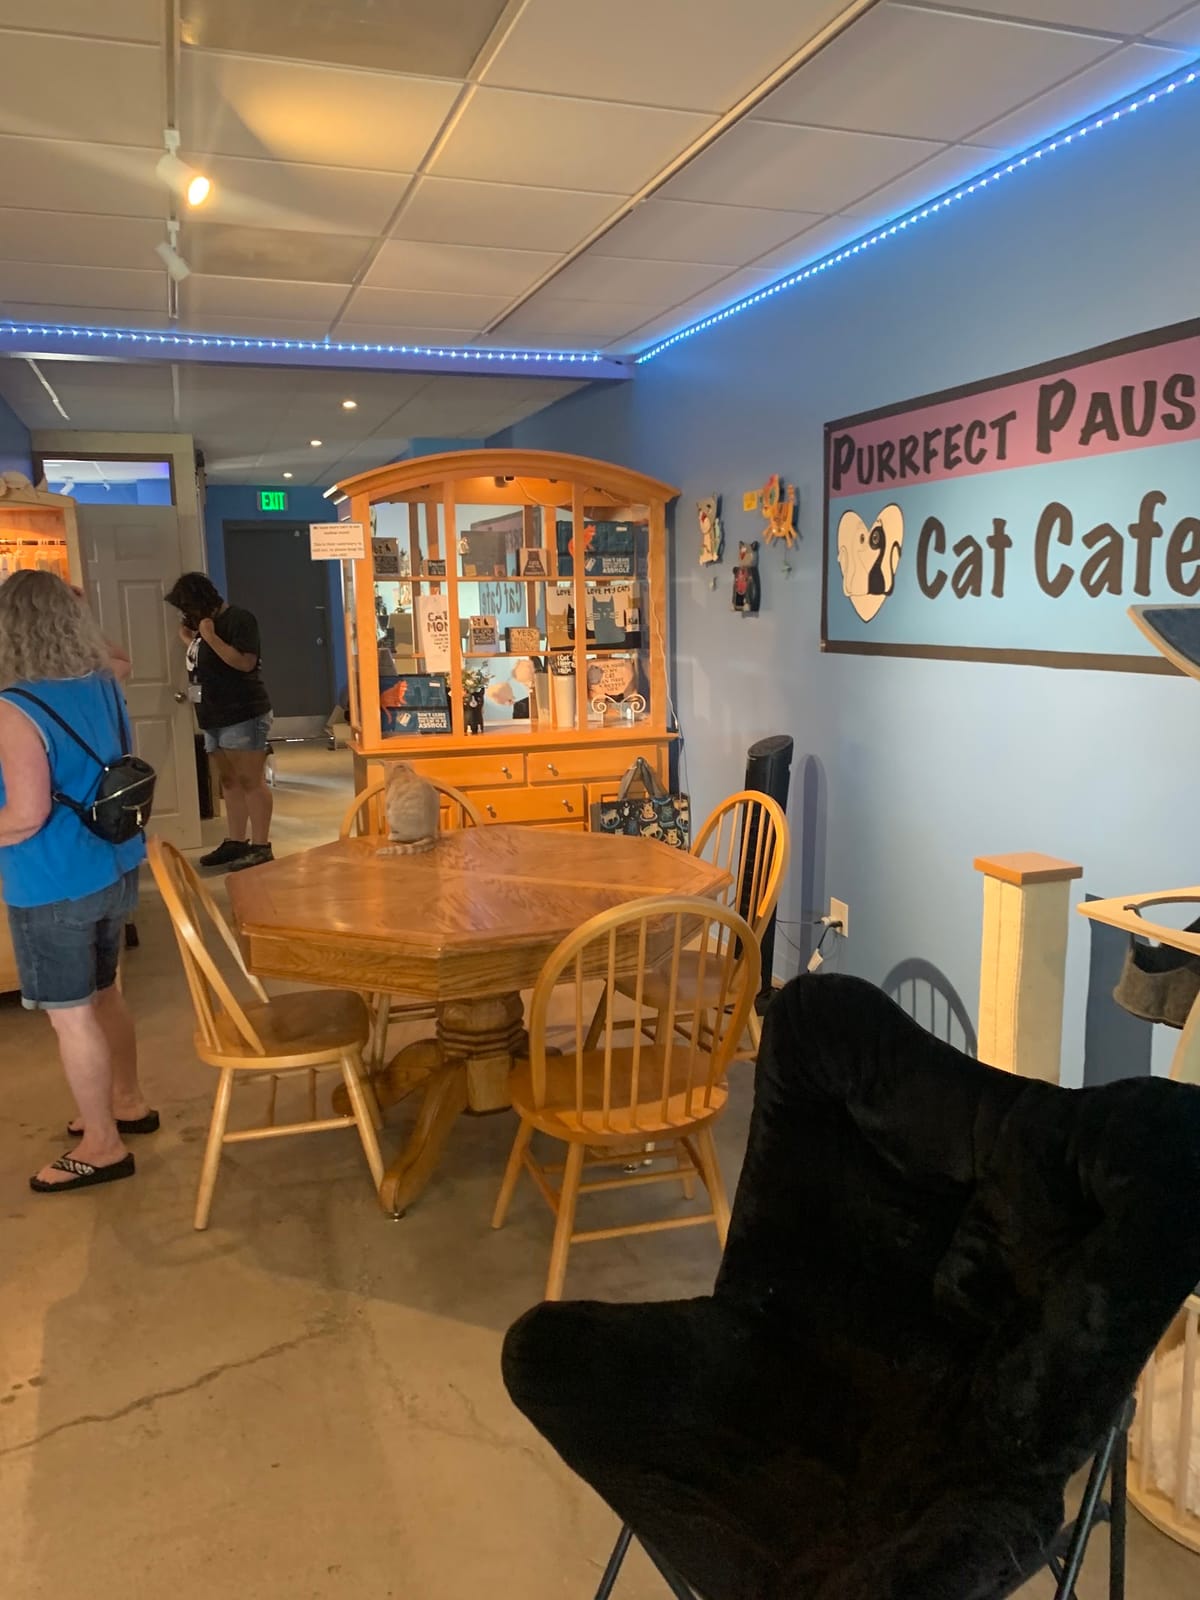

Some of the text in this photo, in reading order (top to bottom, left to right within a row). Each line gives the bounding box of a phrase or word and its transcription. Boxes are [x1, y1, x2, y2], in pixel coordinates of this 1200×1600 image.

[832, 410, 1016, 490] PURRFECT
[261, 491, 285, 510] EXIT
[916, 490, 1200, 599] Cat Cafe
[586, 587, 603, 595] LOVE
